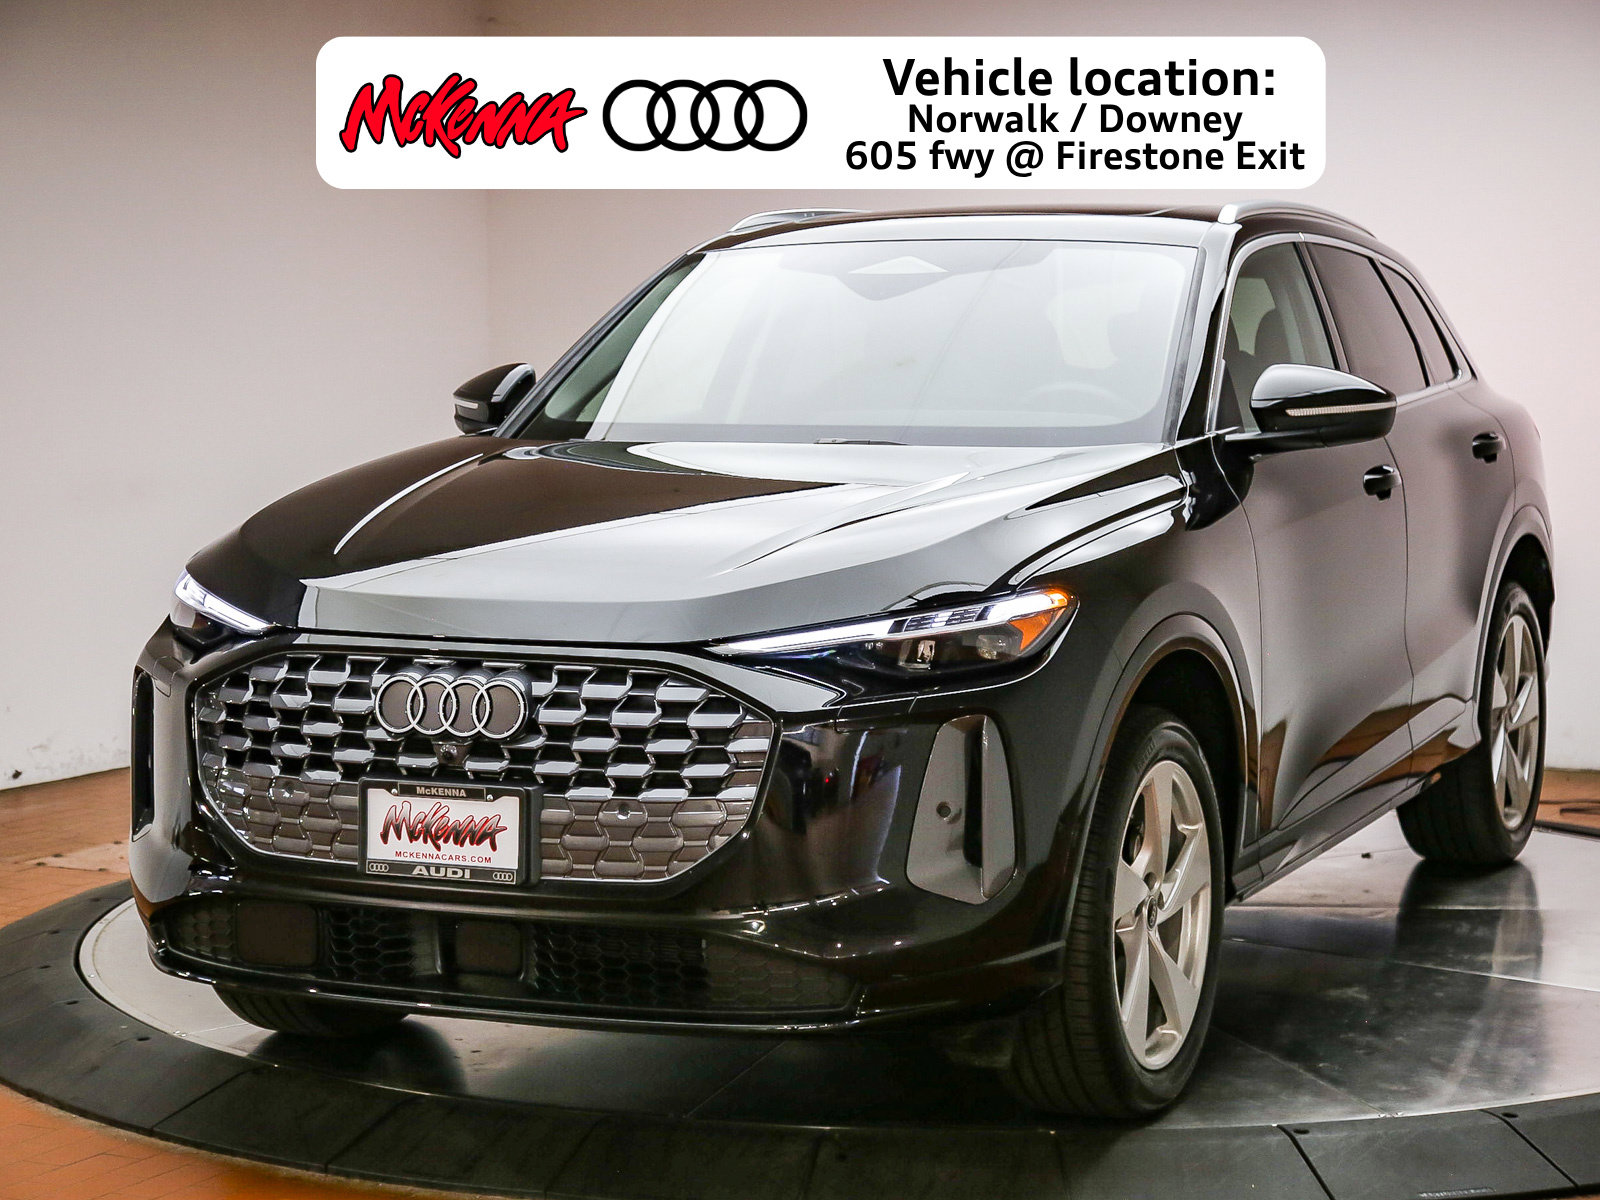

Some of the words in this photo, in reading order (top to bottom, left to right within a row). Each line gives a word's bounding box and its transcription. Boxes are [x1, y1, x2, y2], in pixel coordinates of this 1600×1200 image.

[416, 786, 467, 797] McKENNA
[395, 851, 492, 863] MCKENNACARS.COM
[411, 865, 471, 879] AUDI
